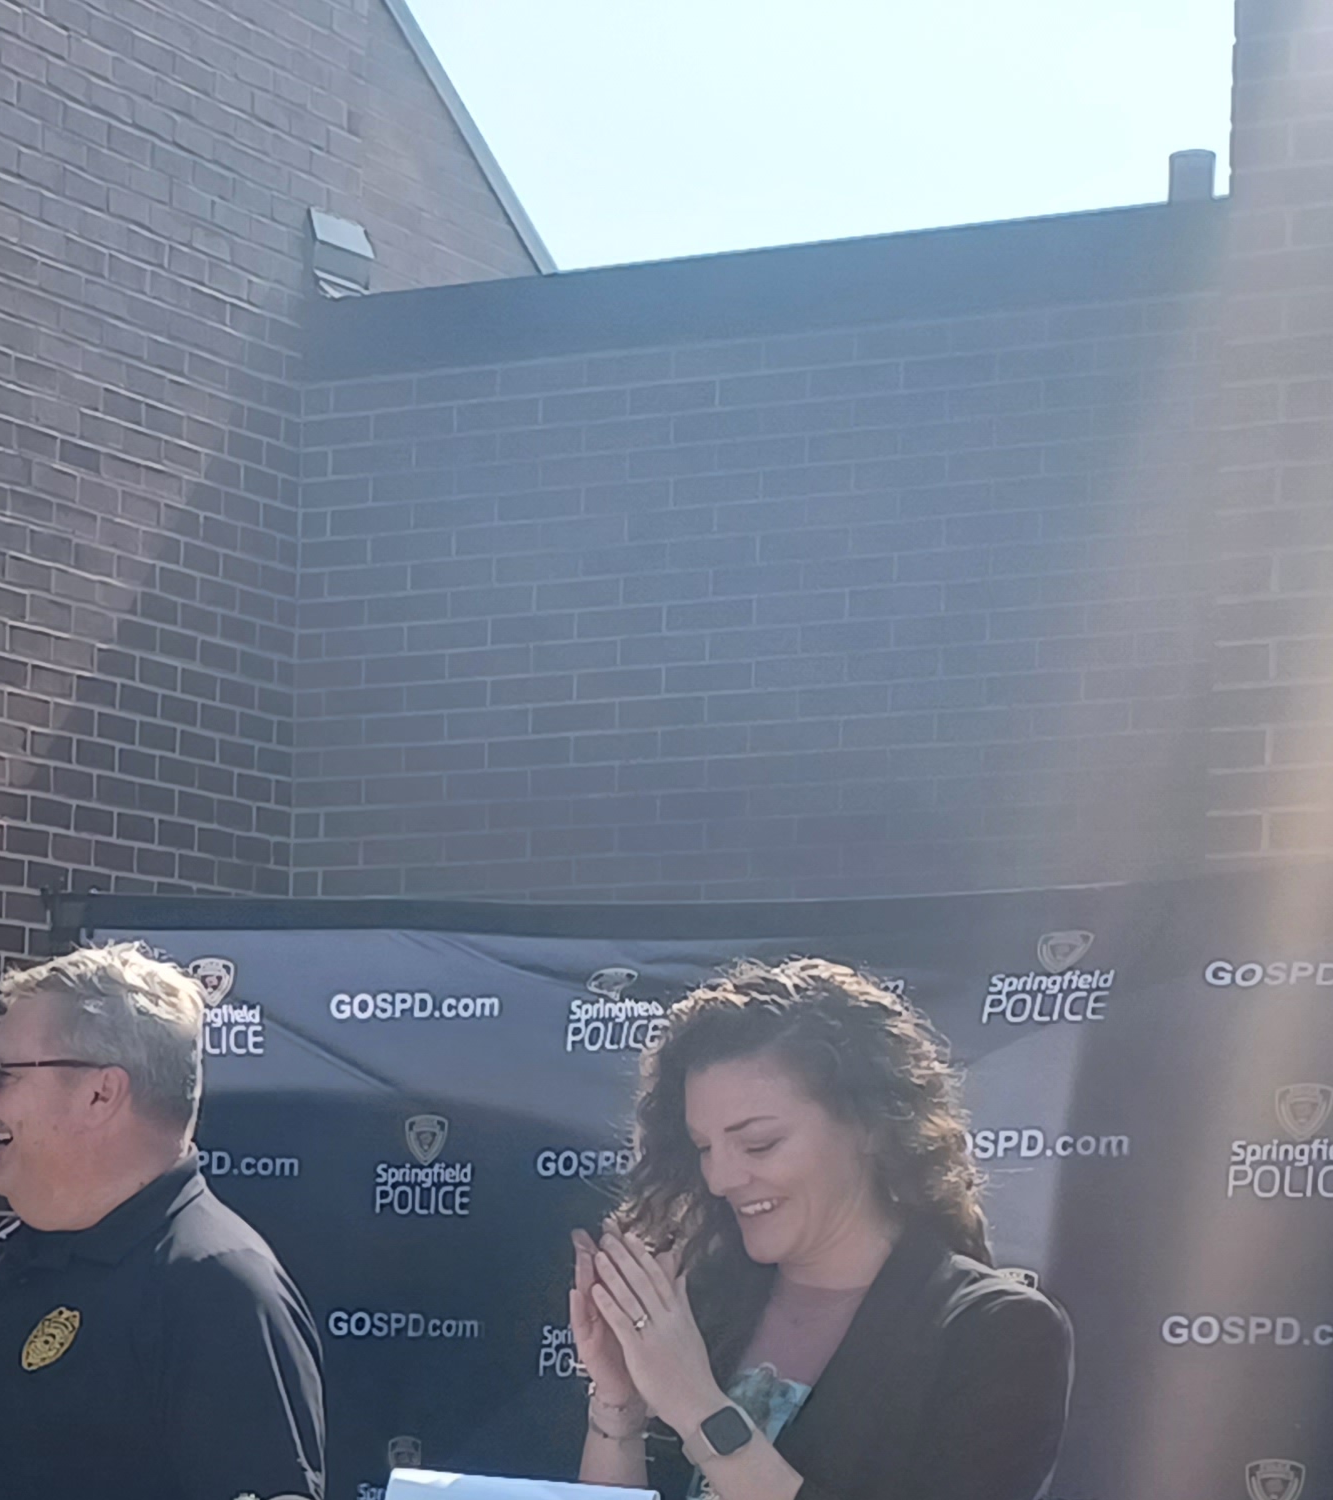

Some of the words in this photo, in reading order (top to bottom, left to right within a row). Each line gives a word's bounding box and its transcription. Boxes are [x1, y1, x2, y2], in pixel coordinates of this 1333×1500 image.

[988, 970, 1115, 1000] Springfield
[1204, 961, 1333, 988] GOSPD
[203, 1003, 261, 1028] ngfield
[329, 992, 500, 1020] GOSPD.com
[569, 997, 666, 1023] Springfield
[981, 990, 1110, 1024] POLICE
[204, 1025, 264, 1055] LICE
[964, 1128, 1130, 1159] SPD.com
[1230, 1138, 1333, 1167] Springfi
[196, 1150, 300, 1177] PD.com
[375, 1161, 473, 1188] Springfield
[536, 1150, 636, 1177] GOSPD
[1227, 1164, 1333, 1199] POLIC
[375, 1185, 471, 1215] POLICE
[328, 1311, 480, 1338] GOSPDcom
[1162, 1315, 1333, 1346] GOSPD.c
